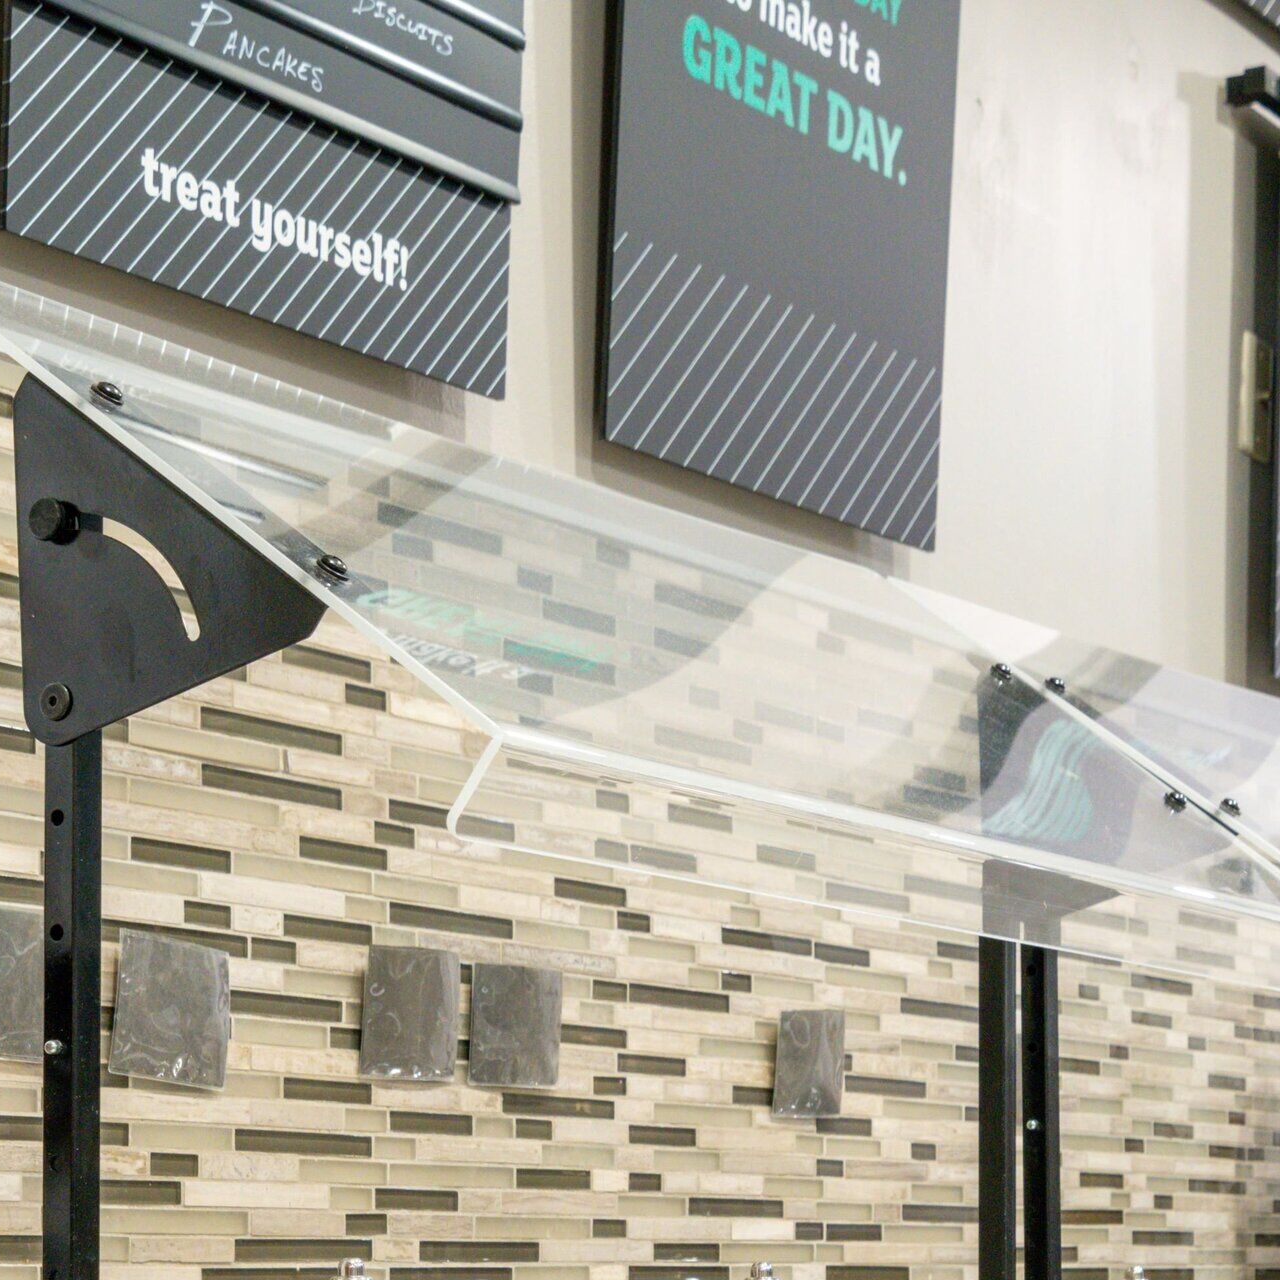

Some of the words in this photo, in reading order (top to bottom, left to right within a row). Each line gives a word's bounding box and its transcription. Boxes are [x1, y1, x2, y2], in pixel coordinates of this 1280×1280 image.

[188, 1, 324, 92] PANCAKES
[682, 14, 818, 135] GREAT
[827, 89, 906, 186] DAY.
[760, 0, 833, 58] make
[839, 20, 860, 74] it
[865, 48, 881, 87] a
[141, 149, 241, 228] treat
[251, 196, 409, 290] yourself!
